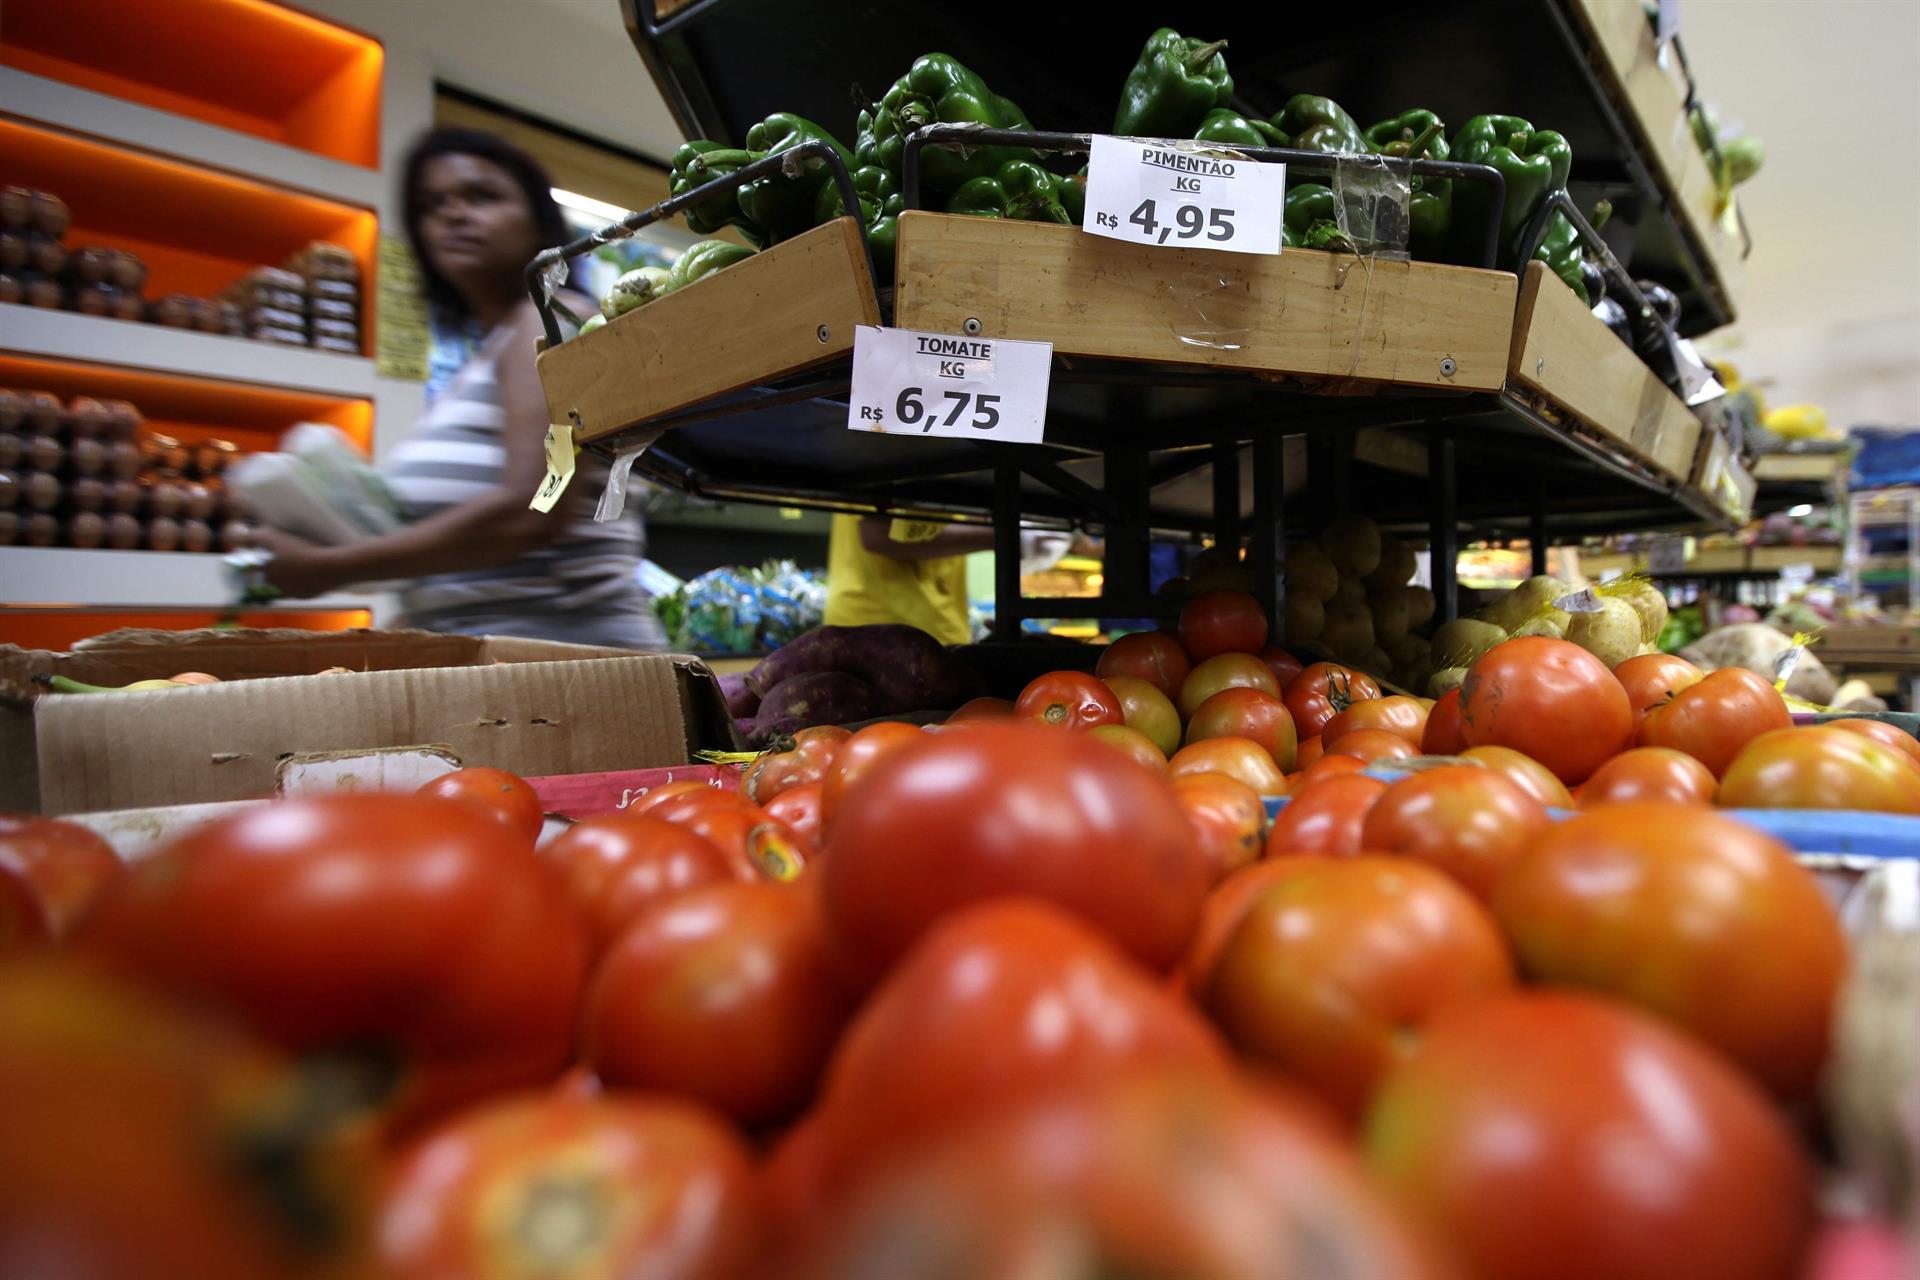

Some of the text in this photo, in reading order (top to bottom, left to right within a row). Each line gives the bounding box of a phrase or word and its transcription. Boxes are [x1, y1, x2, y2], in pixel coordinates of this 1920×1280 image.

[1142, 149, 1235, 176] PIMENTÃO
[1176, 176, 1201, 191] KG
[1096, 198, 1235, 244] R$ 4,95
[917, 337, 991, 358] TOMATE
[939, 361, 965, 376] KG
[860, 387, 1001, 432] R$ 6,75
